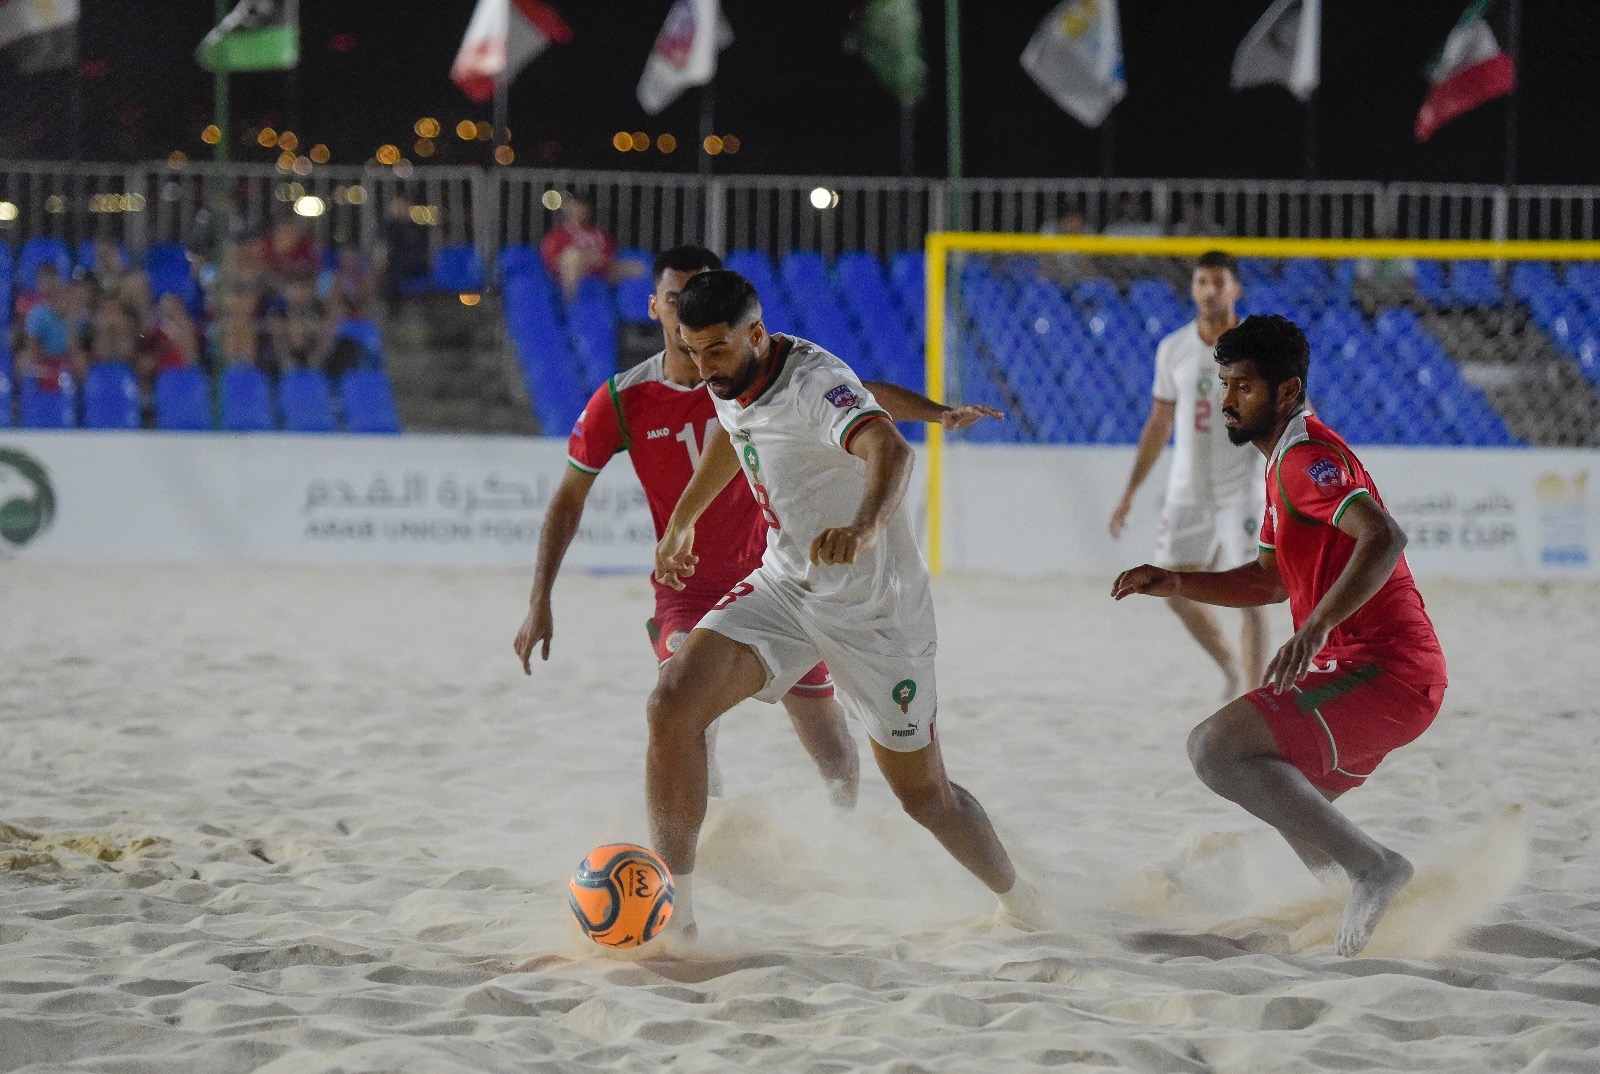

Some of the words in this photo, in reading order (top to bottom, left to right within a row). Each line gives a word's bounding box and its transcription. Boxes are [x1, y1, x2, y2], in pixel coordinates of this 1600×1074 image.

[1194, 399, 1212, 434] 2
[646, 427, 670, 439] JAKO
[891, 729, 915, 737] PUMA
